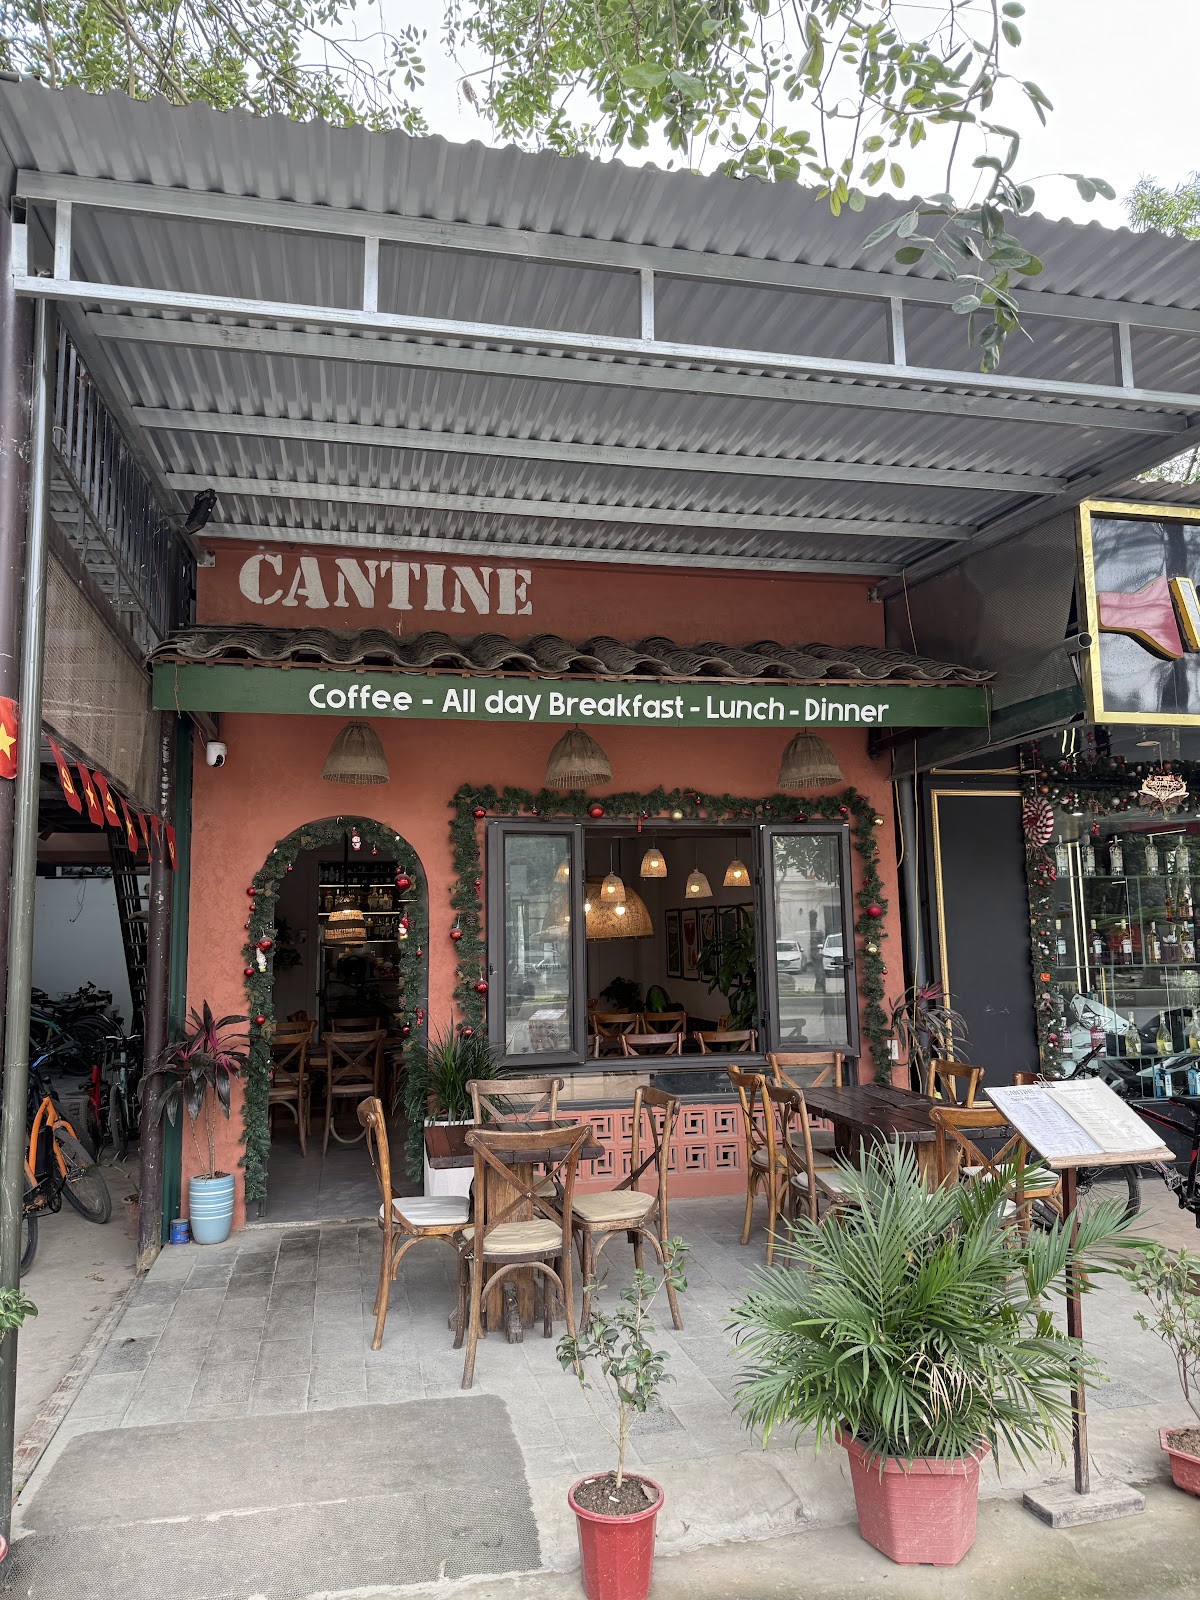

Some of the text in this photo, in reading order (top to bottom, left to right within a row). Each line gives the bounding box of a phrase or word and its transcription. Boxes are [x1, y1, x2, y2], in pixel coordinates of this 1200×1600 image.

[238, 553, 533, 617] CANTINE
[308, 683, 413, 711] Coffee
[441, 688, 476, 713] All
[484, 689, 542, 721] day
[549, 691, 684, 720] Breakfast
[706, 695, 786, 721] Lunch
[804, 697, 890, 724] Dinner
